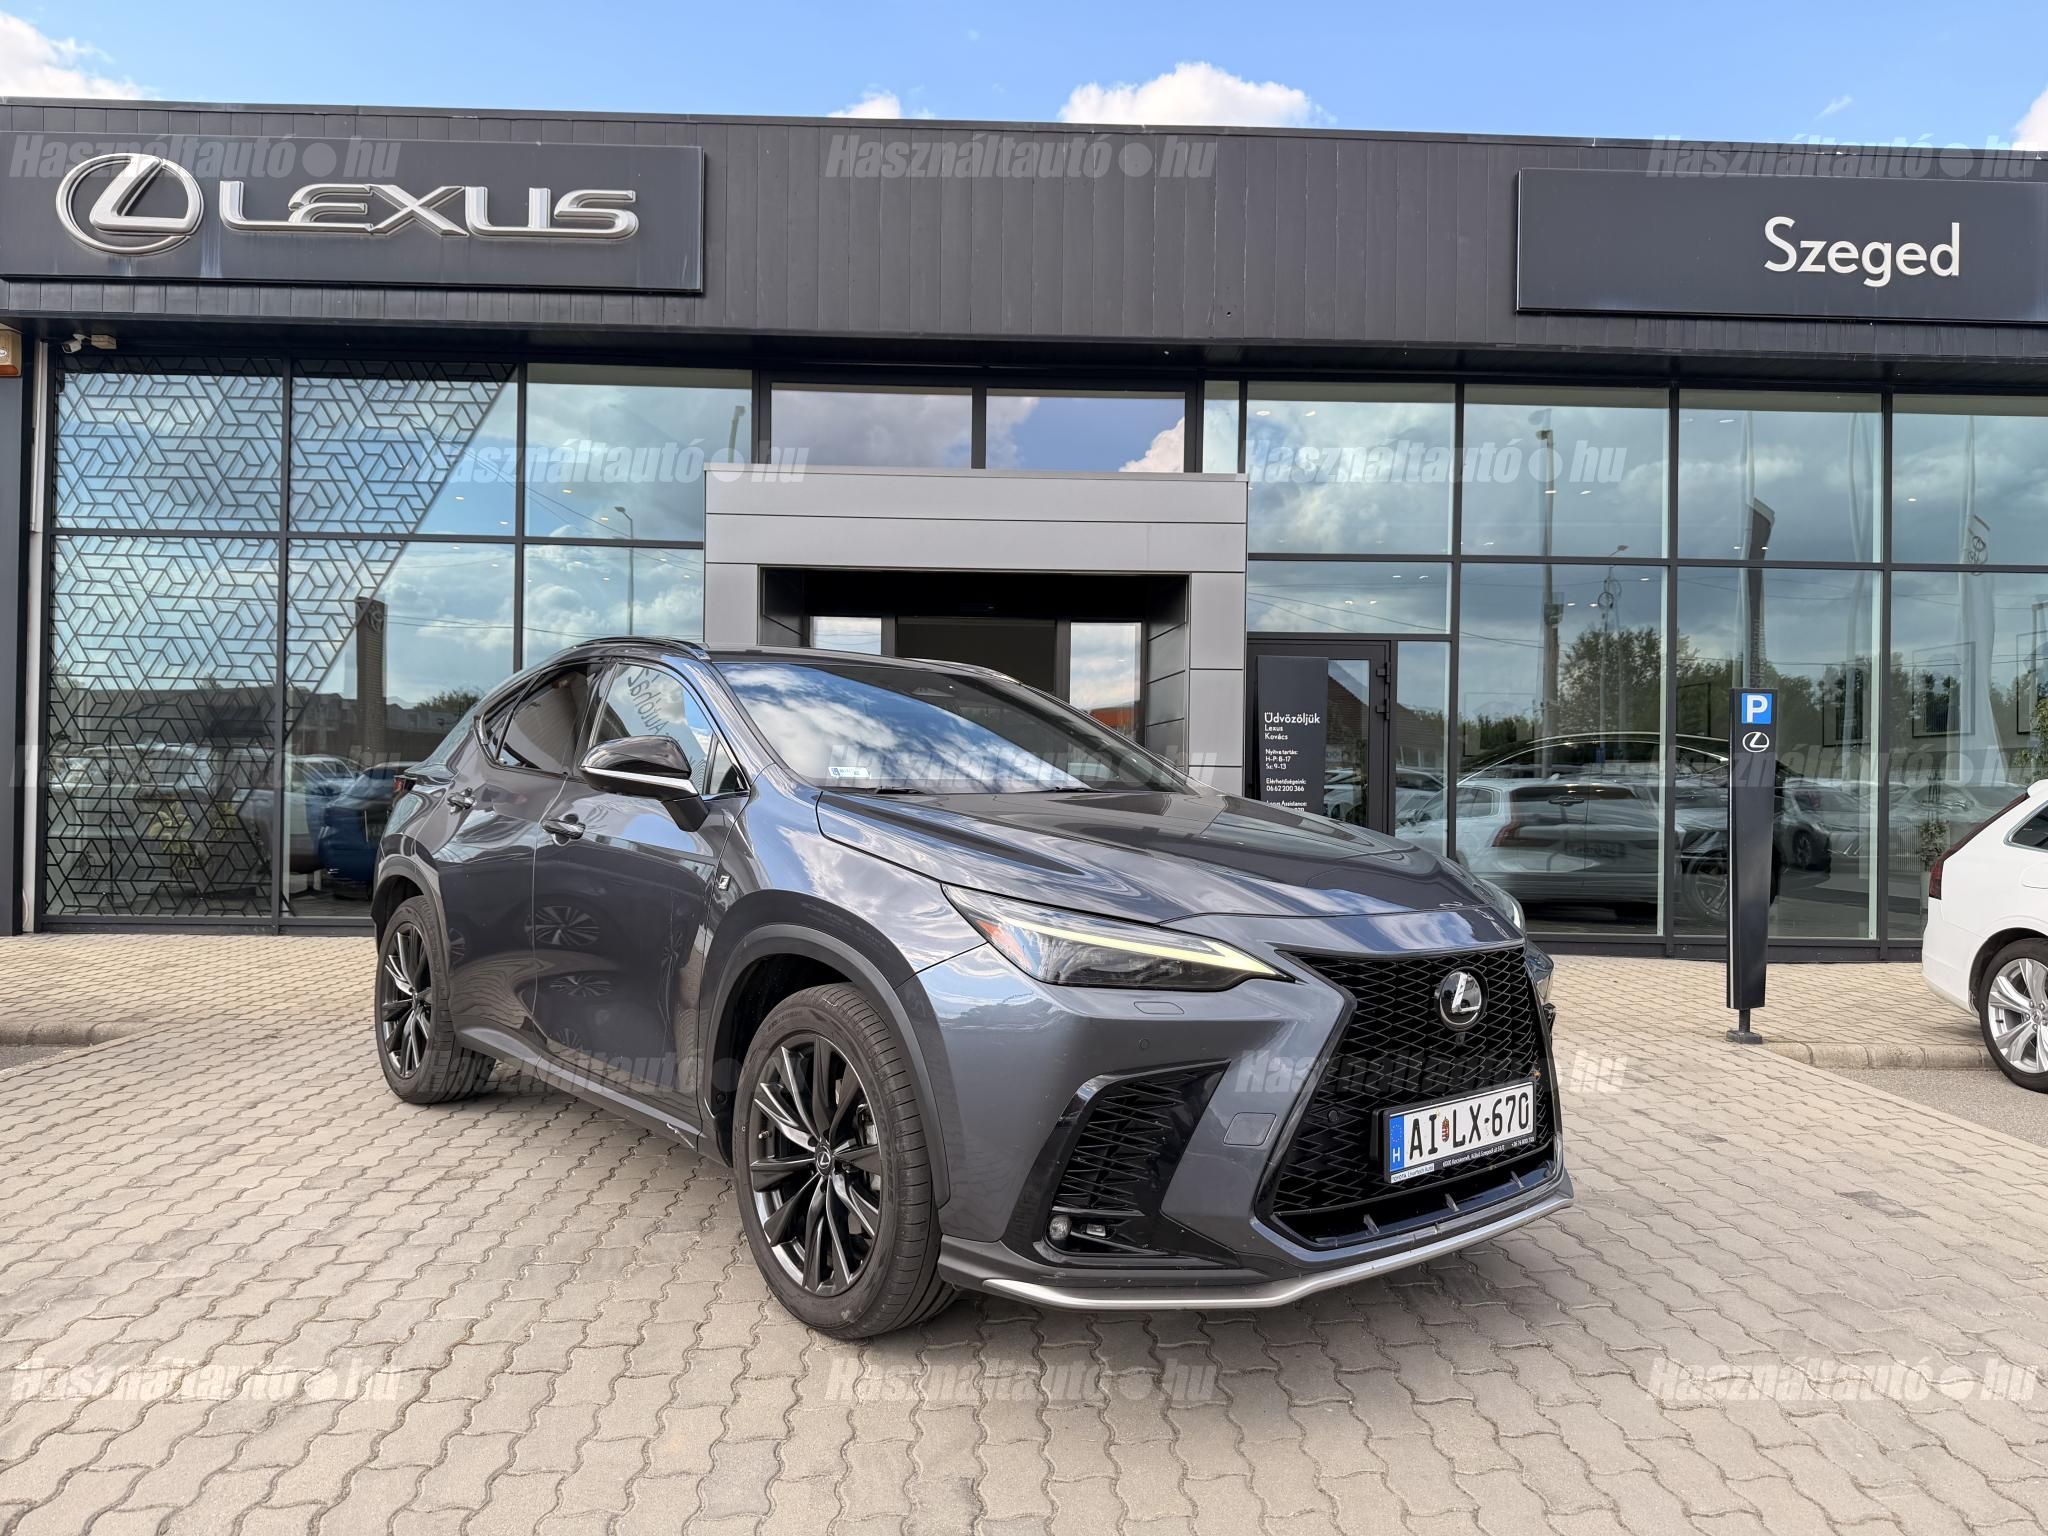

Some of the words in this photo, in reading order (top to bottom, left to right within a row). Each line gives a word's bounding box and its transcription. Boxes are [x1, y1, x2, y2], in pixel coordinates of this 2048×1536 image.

[220, 180, 640, 239] LEXUS
[1764, 216, 1960, 287] Szeged
[1264, 712, 1321, 726] Üdvözöljük
[1747, 694, 1768, 723] P
[1264, 723, 1284, 732] Lexus
[1264, 732, 1289, 740] Kovács
[1392, 1147, 1401, 1163] H
[1409, 1113, 1439, 1160] AI
[1452, 1092, 1530, 1148] LX-670
